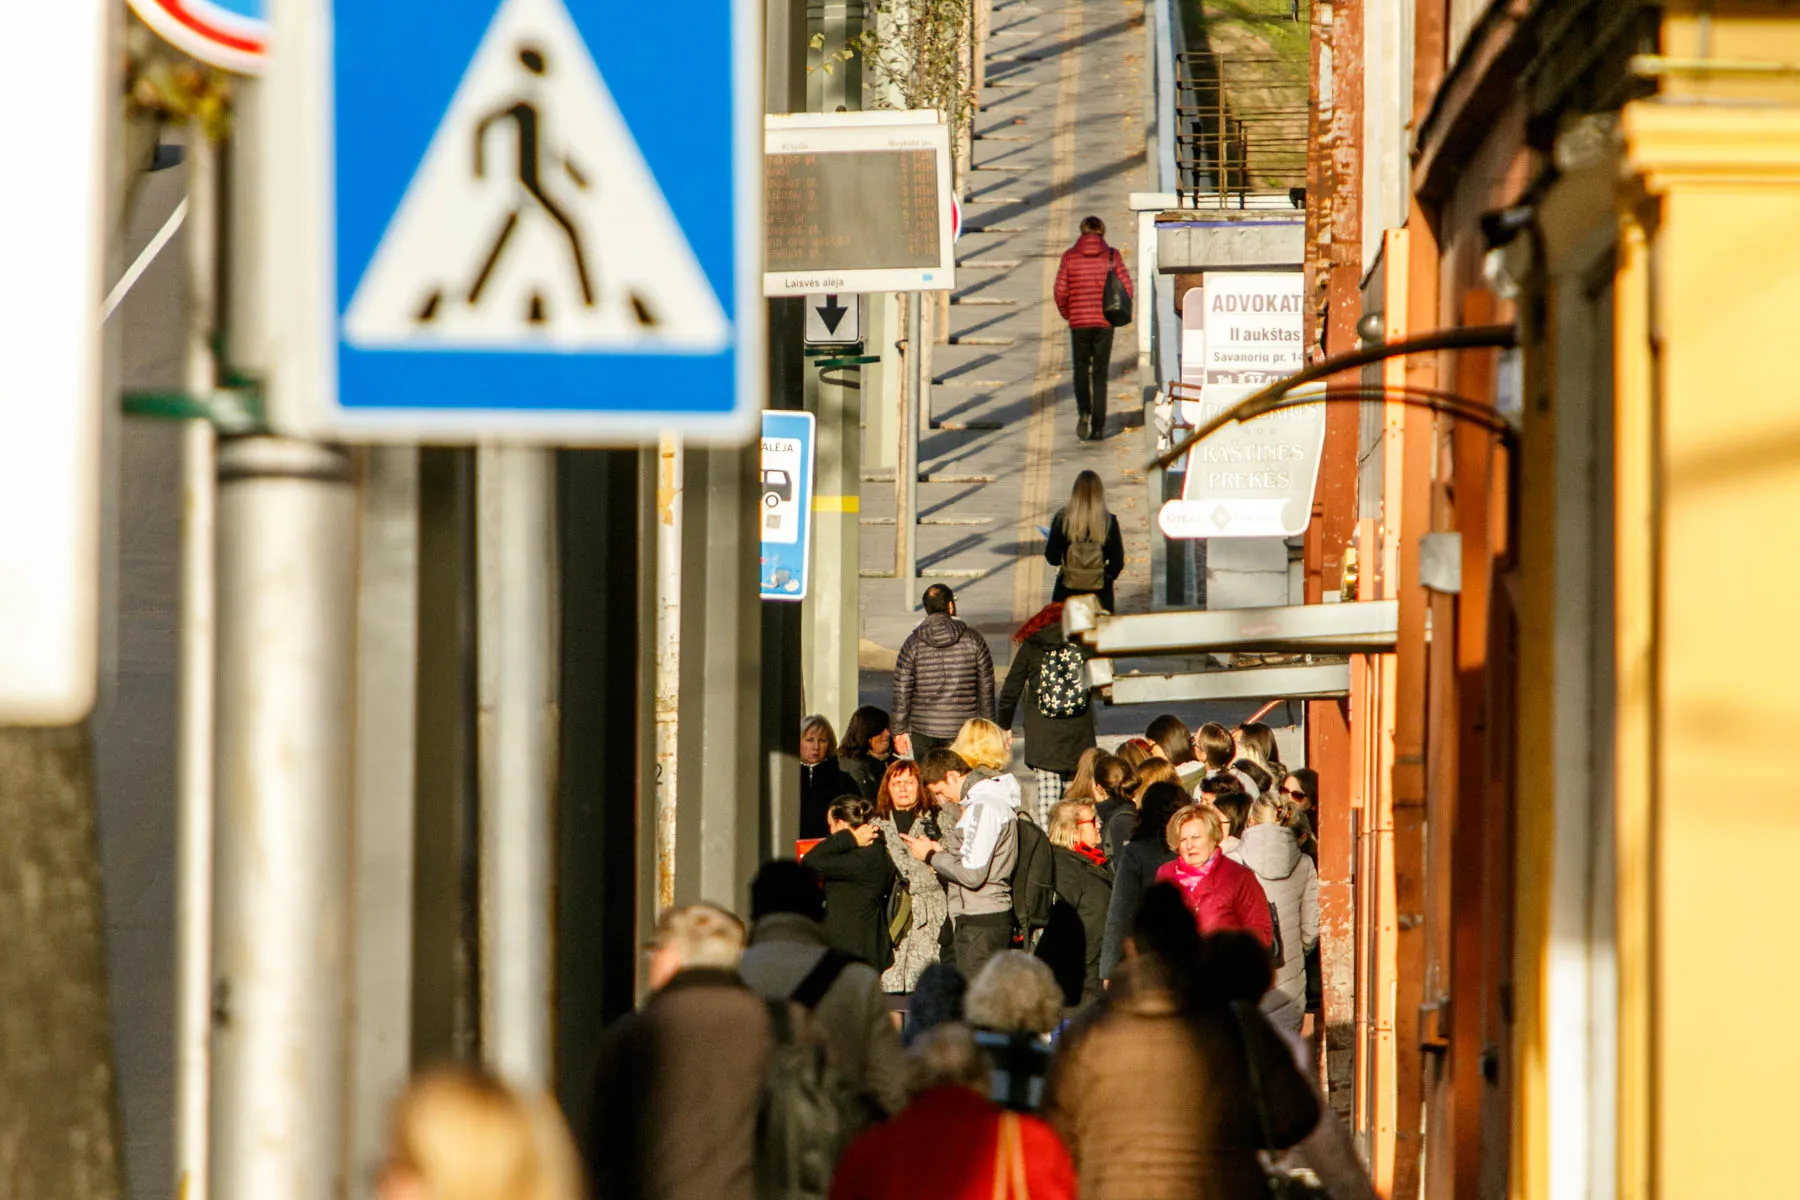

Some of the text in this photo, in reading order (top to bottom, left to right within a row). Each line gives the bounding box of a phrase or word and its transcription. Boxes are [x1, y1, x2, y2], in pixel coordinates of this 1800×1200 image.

[785, 276, 844, 289] Laisvės alėja
[1243, 326, 1301, 342] aukštas
[1273, 353, 1287, 364] pr.
[1208, 465, 1291, 489] PREKĖS
